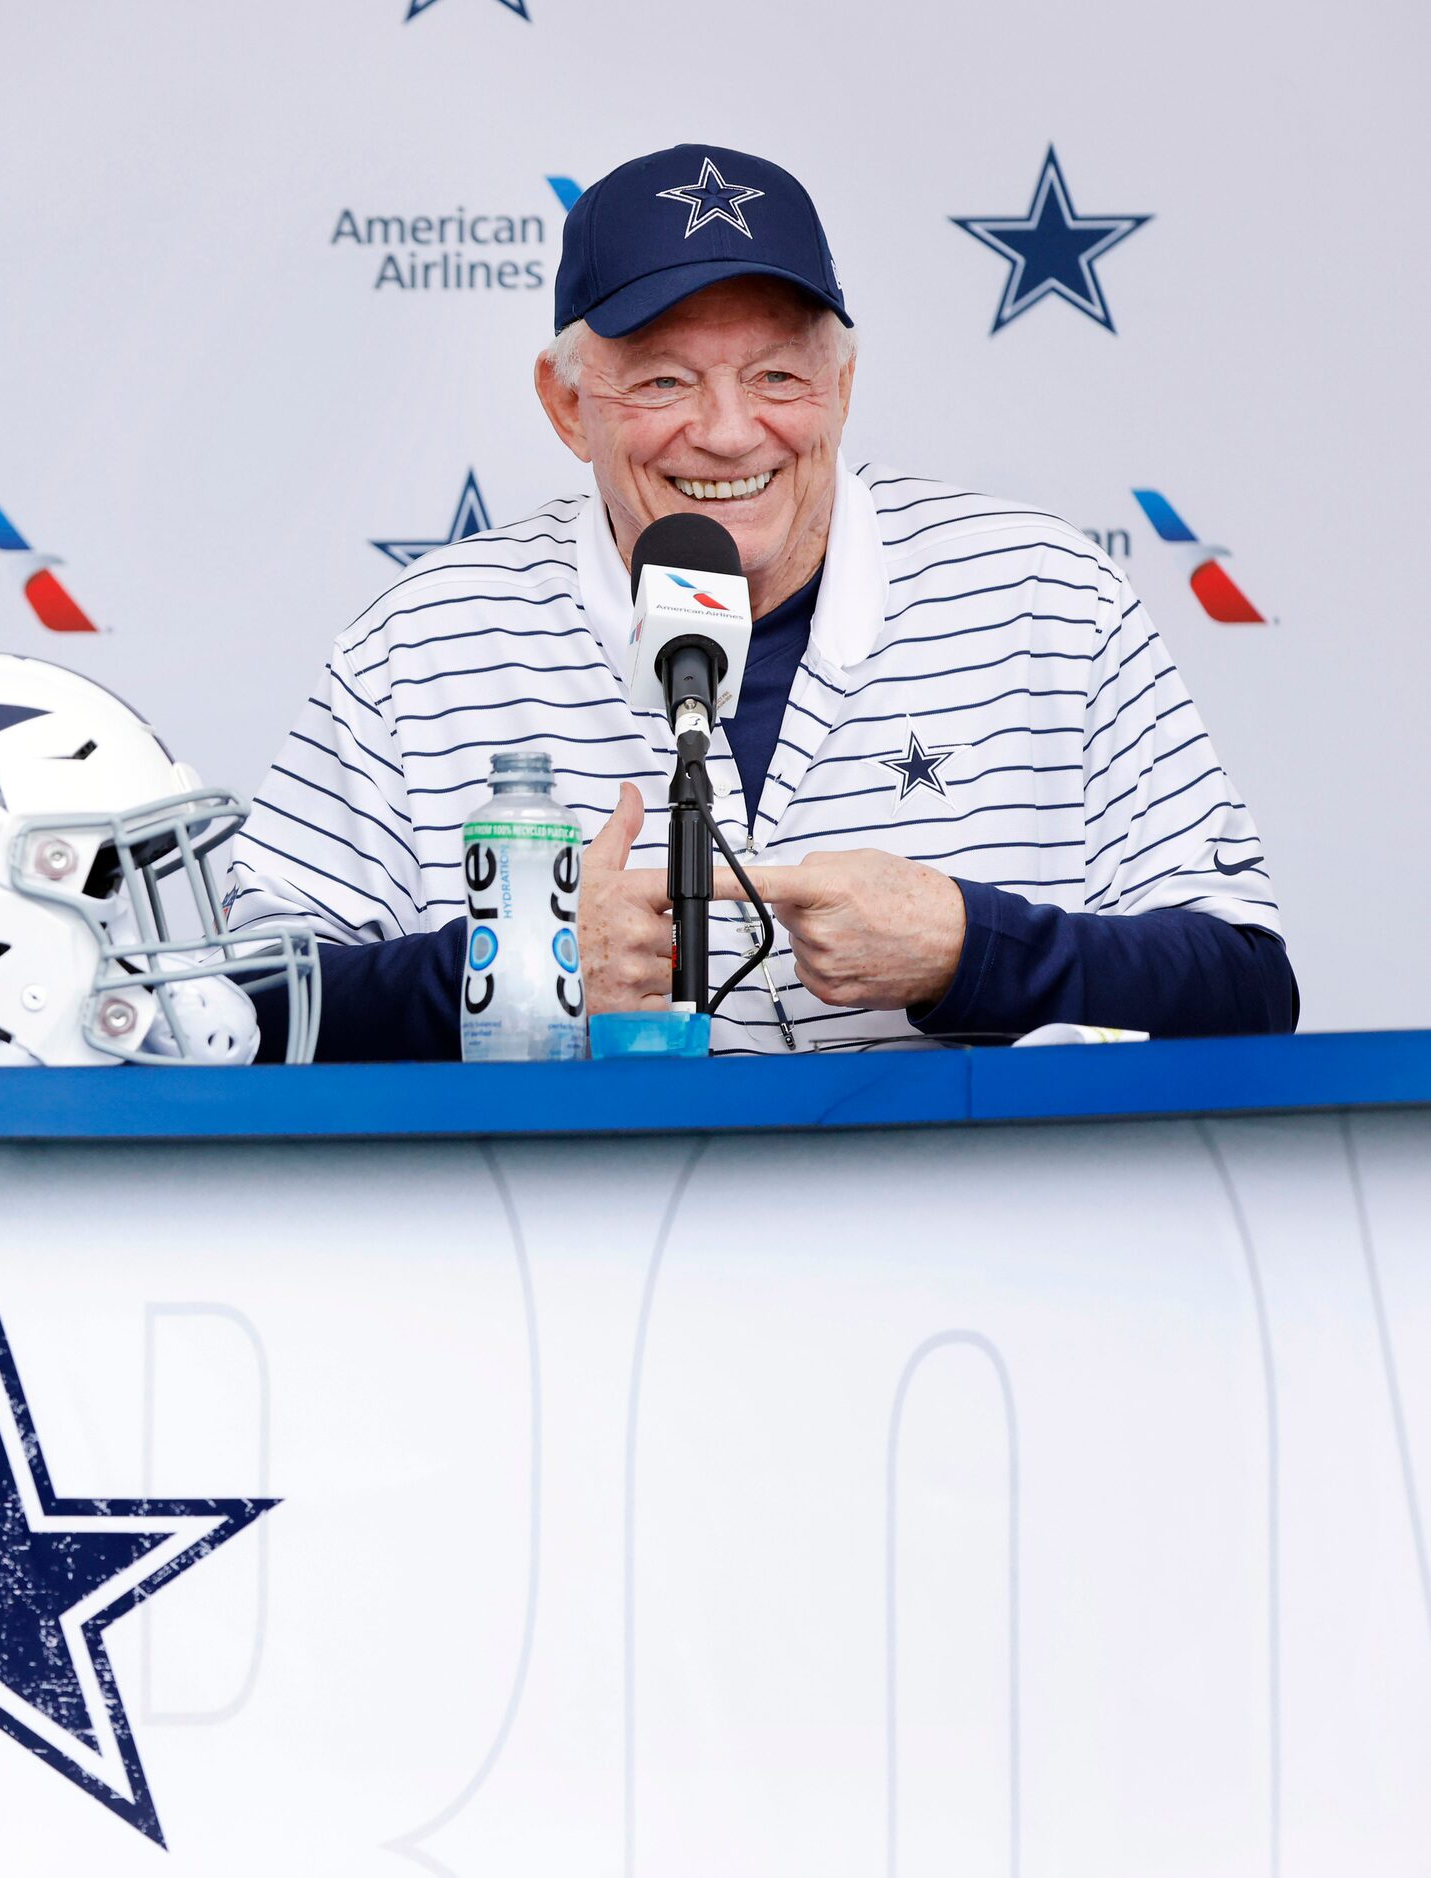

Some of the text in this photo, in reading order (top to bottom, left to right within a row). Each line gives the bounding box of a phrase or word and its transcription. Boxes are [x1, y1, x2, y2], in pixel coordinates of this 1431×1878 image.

[331, 207, 544, 245] American
[374, 252, 544, 290] Airlines
[656, 603, 744, 620] American Airlines
[513, 825, 546, 837] RECYCLED
[500, 844, 512, 919] HYDRATION
[464, 843, 498, 1015] core
[550, 846, 584, 1018] core
